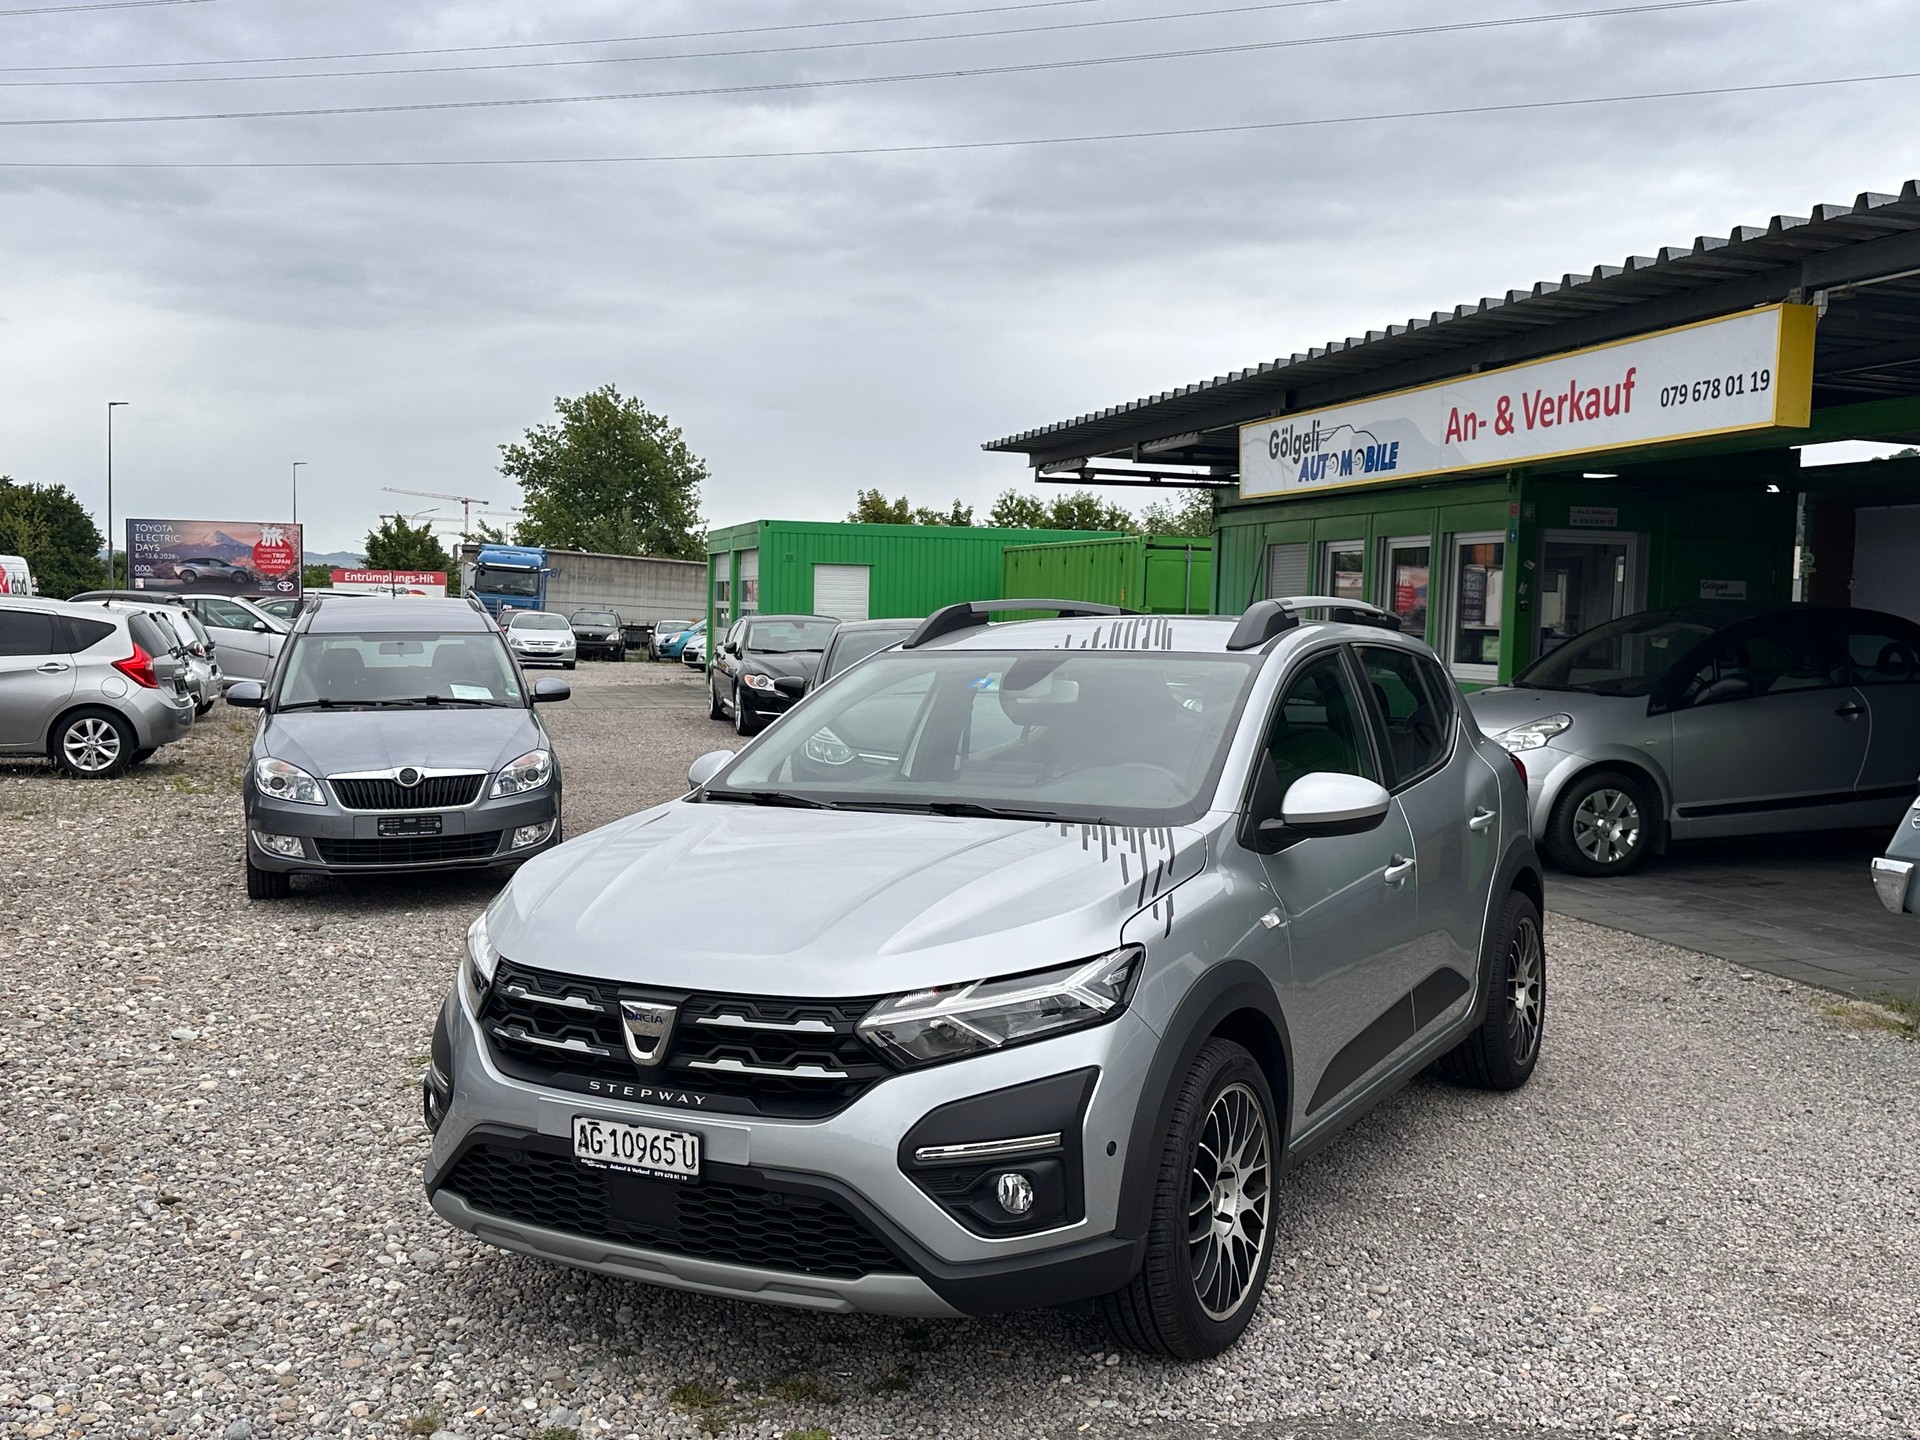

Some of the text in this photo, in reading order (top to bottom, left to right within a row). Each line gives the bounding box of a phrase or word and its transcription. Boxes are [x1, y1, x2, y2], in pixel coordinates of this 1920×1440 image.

[1660, 369, 1771, 408] 079 678 01 19
[1445, 367, 1637, 444] An- & Verkauf
[1269, 420, 1321, 465] Gölgeli
[135, 523, 174, 532] TOYOTA
[135, 533, 181, 543] ELECTRIC
[135, 543, 160, 552] DAYS
[344, 571, 435, 585] Entrümplungs-Hit
[625, 1010, 664, 1025] DACIA
[589, 1081, 706, 1105] STEPWAY
